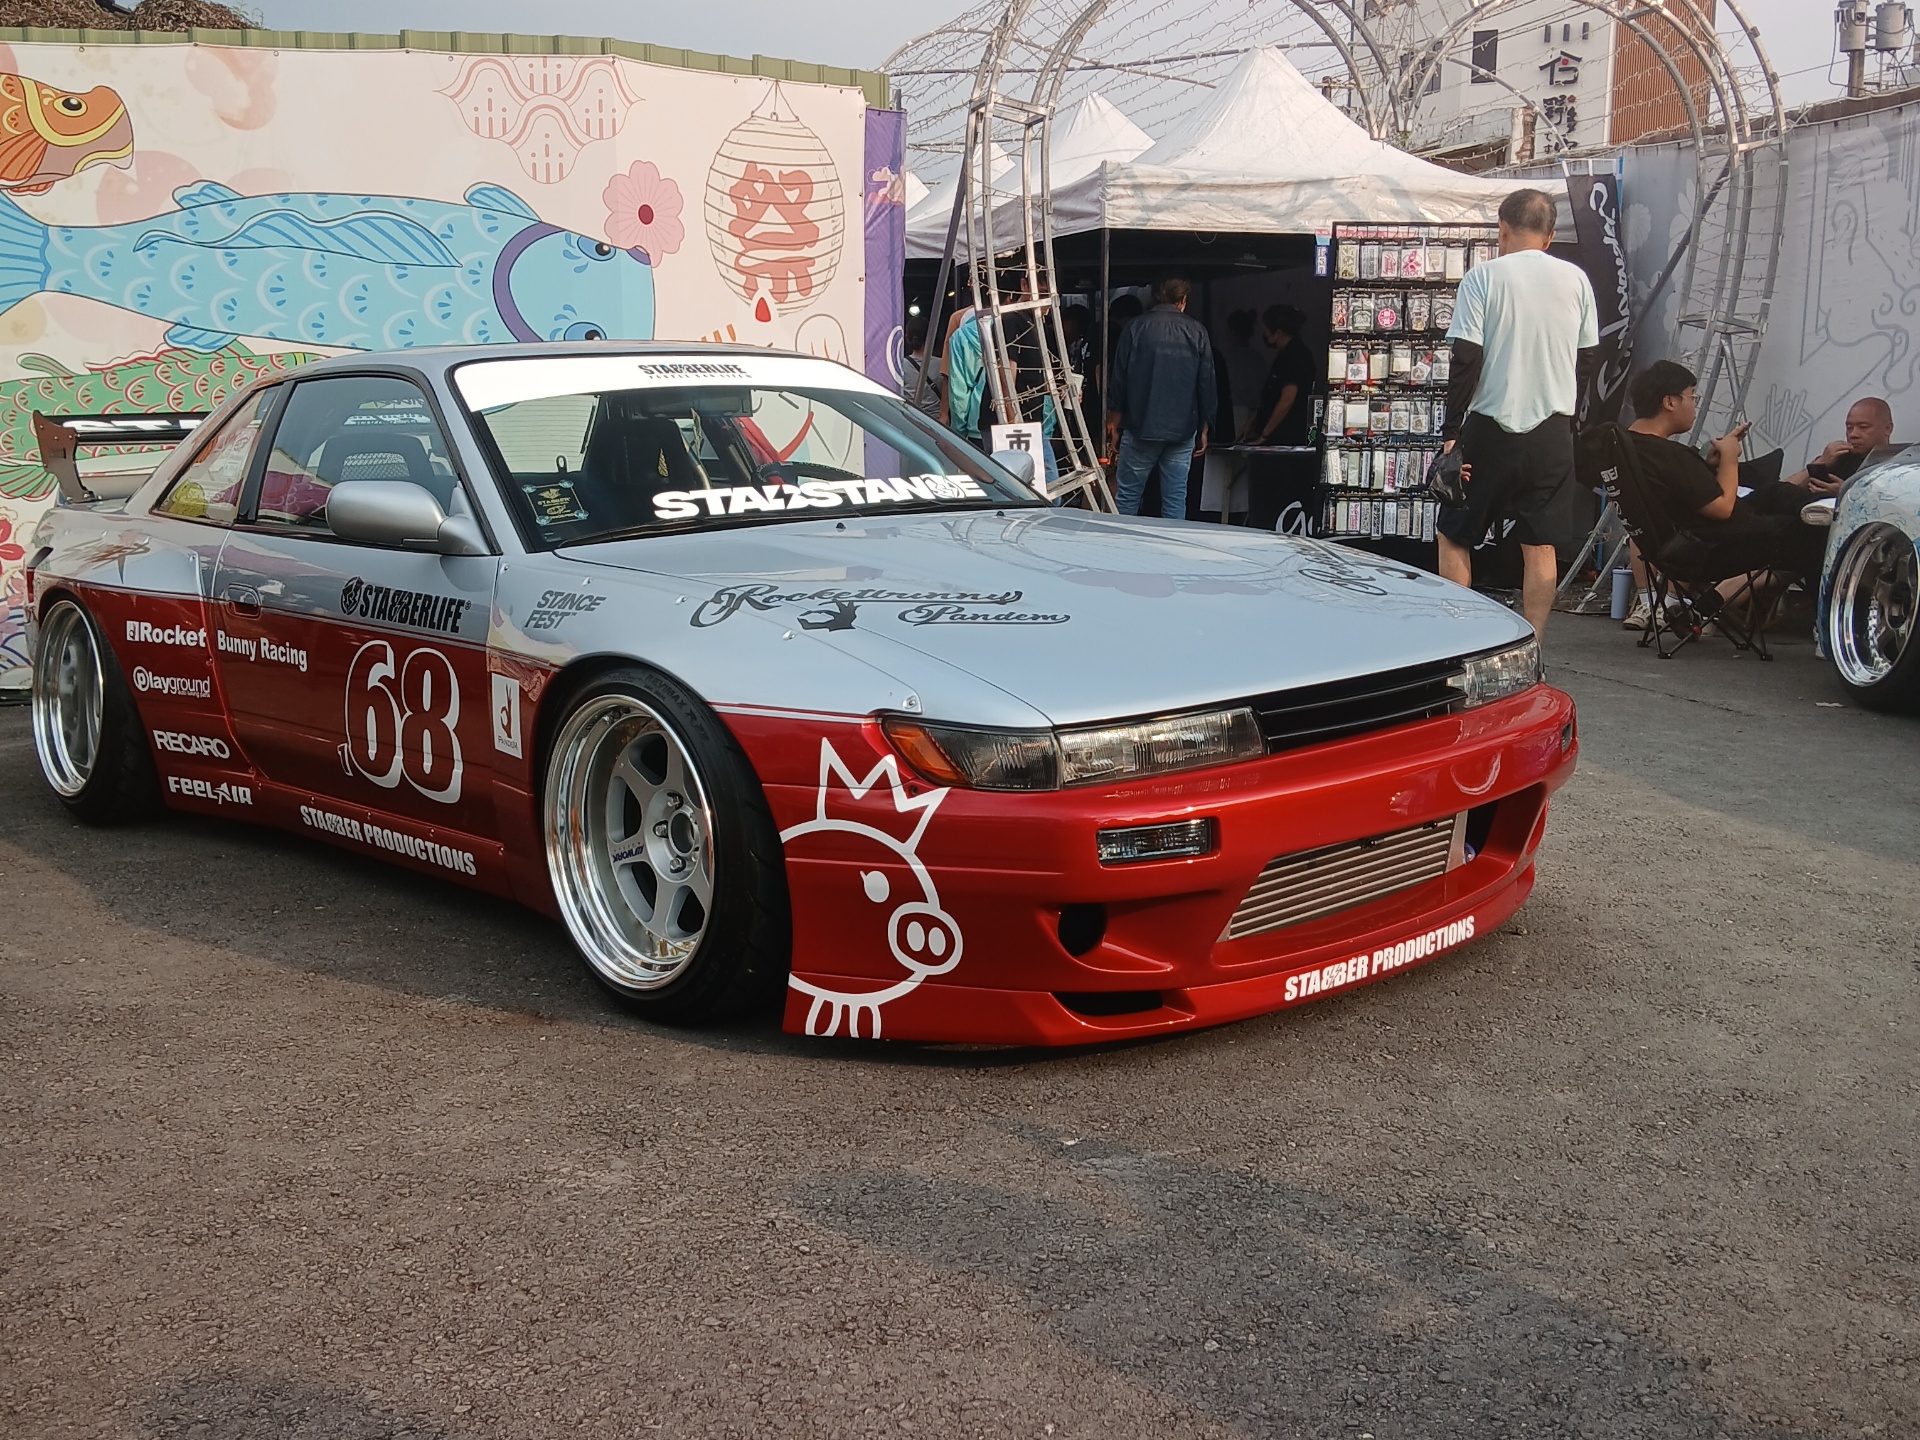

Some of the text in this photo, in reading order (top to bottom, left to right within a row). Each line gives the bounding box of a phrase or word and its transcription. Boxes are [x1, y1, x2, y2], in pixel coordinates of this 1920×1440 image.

[536, 590, 607, 612] STANCE
[897, 603, 1071, 627] Pandem
[140, 621, 308, 673] Rocket Bunny Racing
[152, 729, 231, 759] RECARO
[363, 822, 477, 876] PRODUCTIONS
[1371, 915, 1475, 975] PRODUCTIONS
